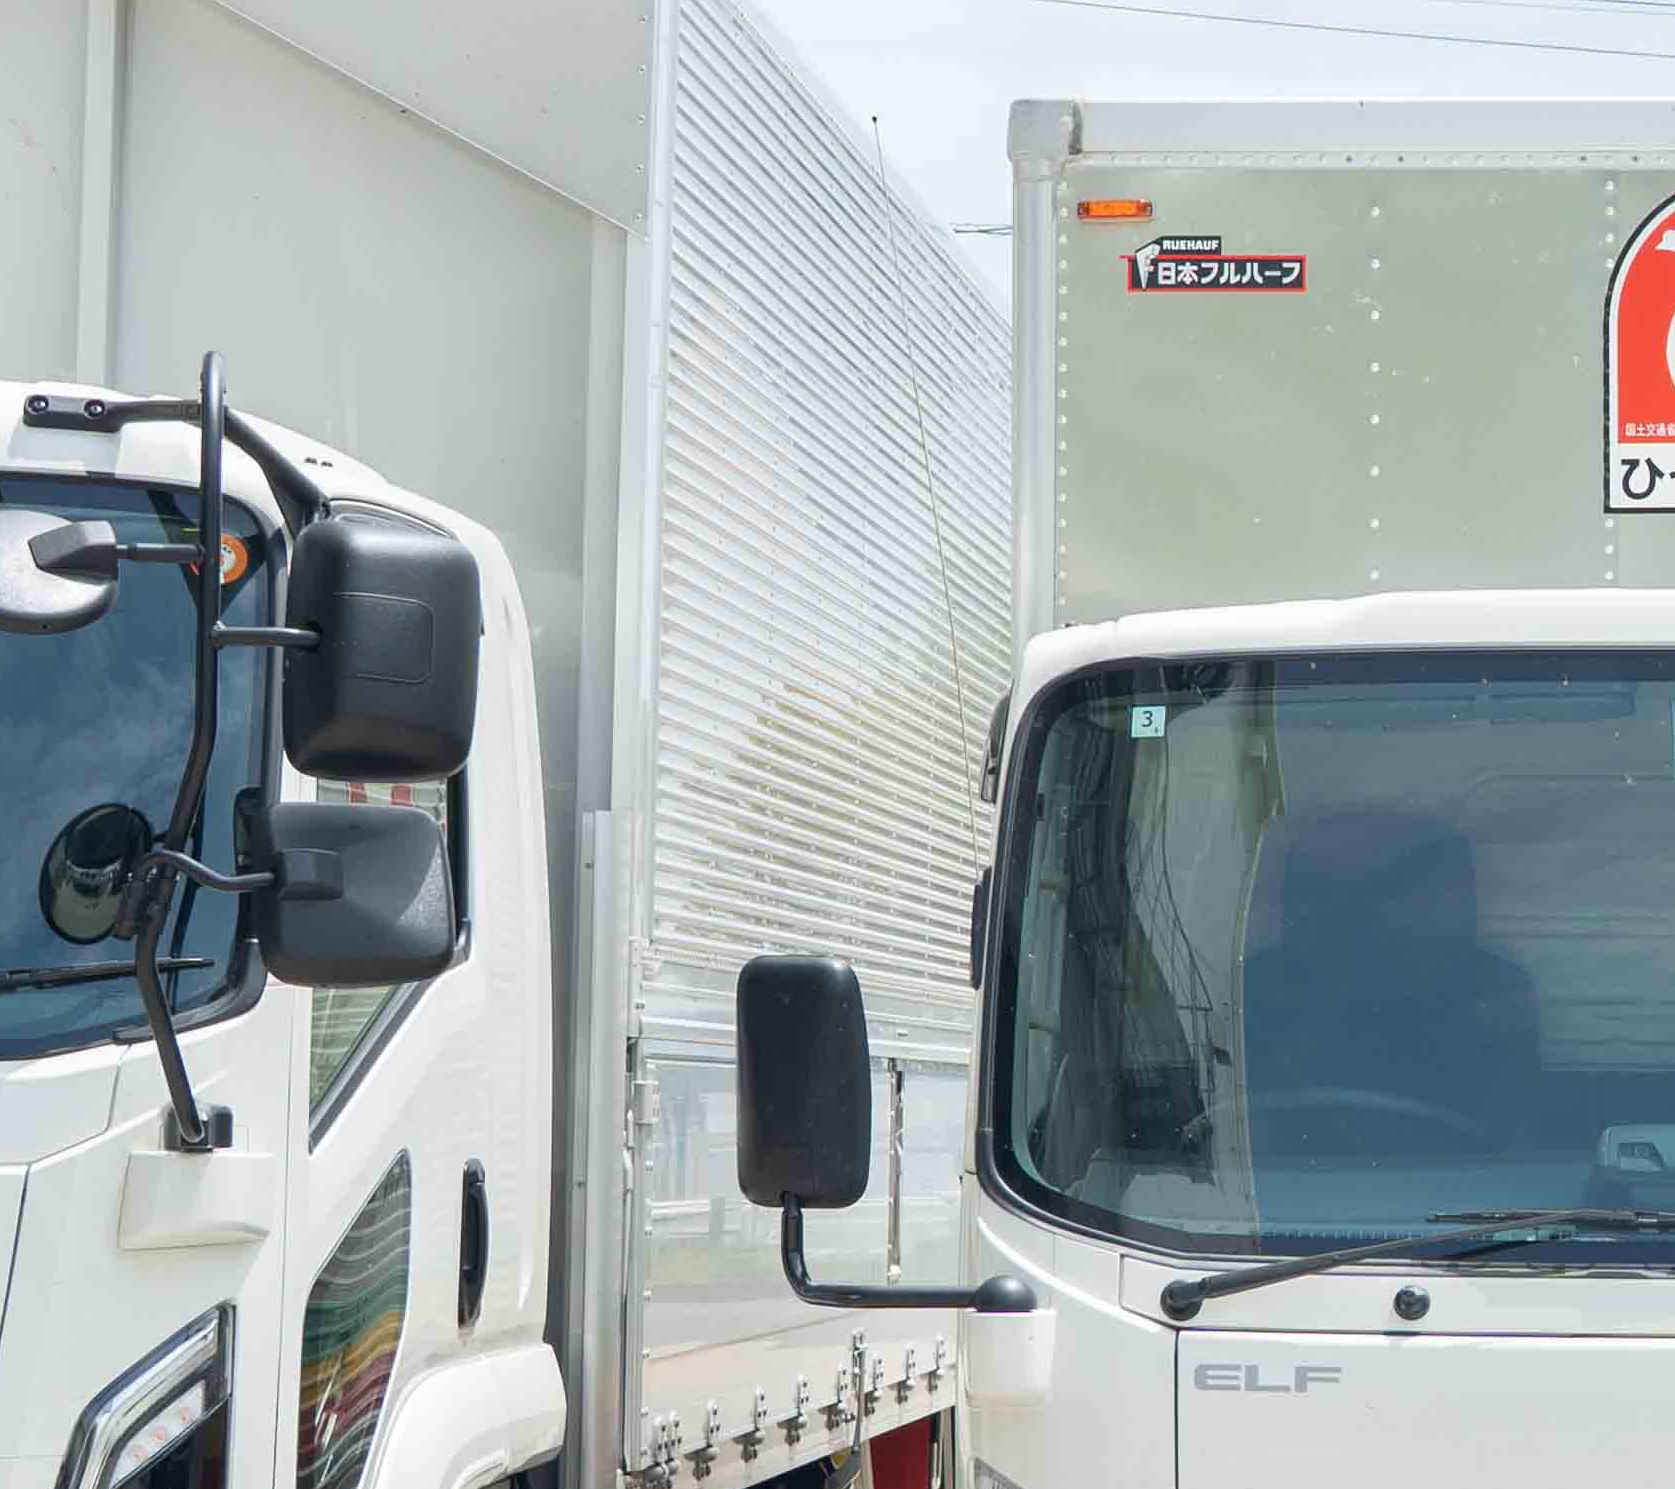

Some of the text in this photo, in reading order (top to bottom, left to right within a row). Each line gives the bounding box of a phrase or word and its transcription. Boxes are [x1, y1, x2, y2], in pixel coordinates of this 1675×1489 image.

[1157, 262, 1301, 285] 日本フルハーフ
[1140, 710, 1154, 728] 3
[1194, 1364, 1342, 1393] ELF
